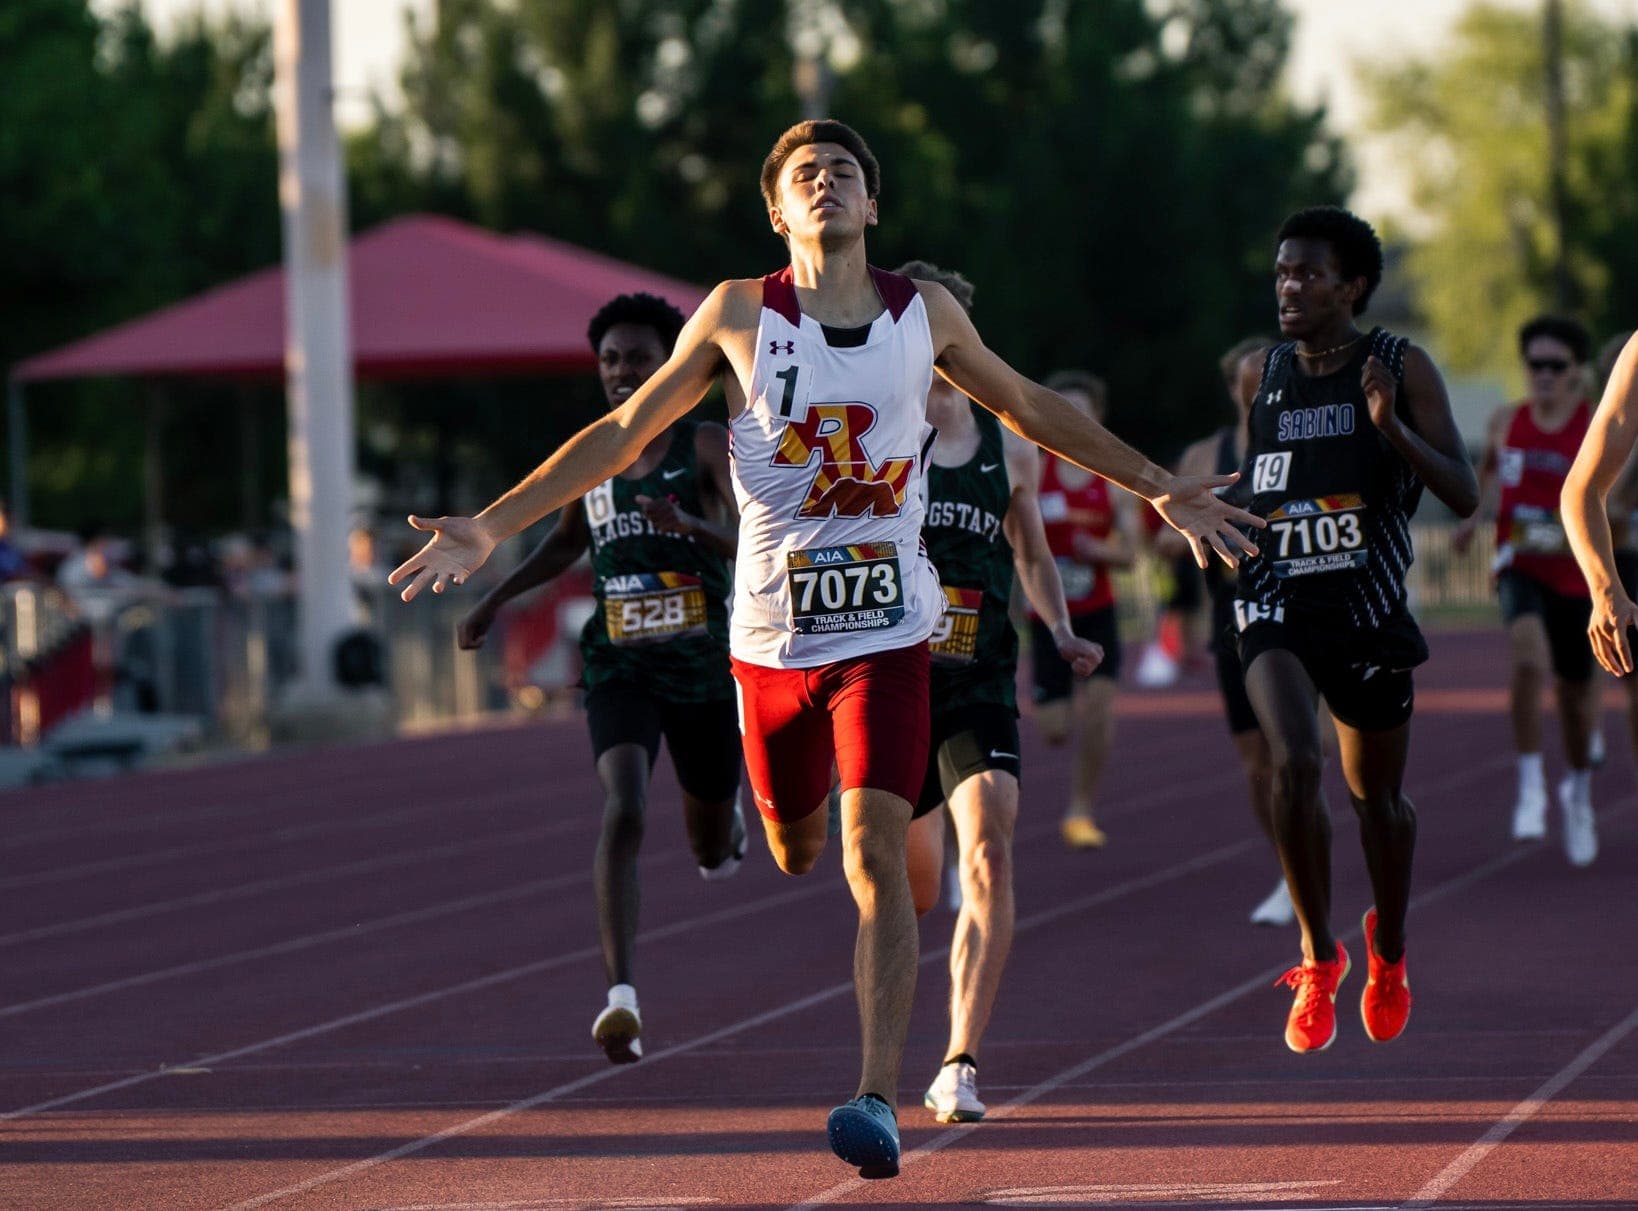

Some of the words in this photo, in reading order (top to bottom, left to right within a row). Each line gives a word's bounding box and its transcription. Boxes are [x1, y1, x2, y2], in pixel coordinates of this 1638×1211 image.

[775, 364, 799, 417] 1
[1278, 403, 1355, 441] SABINO
[1257, 454, 1285, 491] 19
[1288, 502, 1314, 515] AIA
[1271, 513, 1362, 557] 7103
[814, 551, 844, 563] AIA
[604, 574, 644, 592] AIA
[793, 563, 898, 612] 7073
[622, 594, 684, 632] 528
[811, 617, 890, 633] CHAMPIONSHIPS
[814, 615, 847, 625] TRACK
[848, 613, 856, 621] &
[858, 610, 884, 620] FIELD
